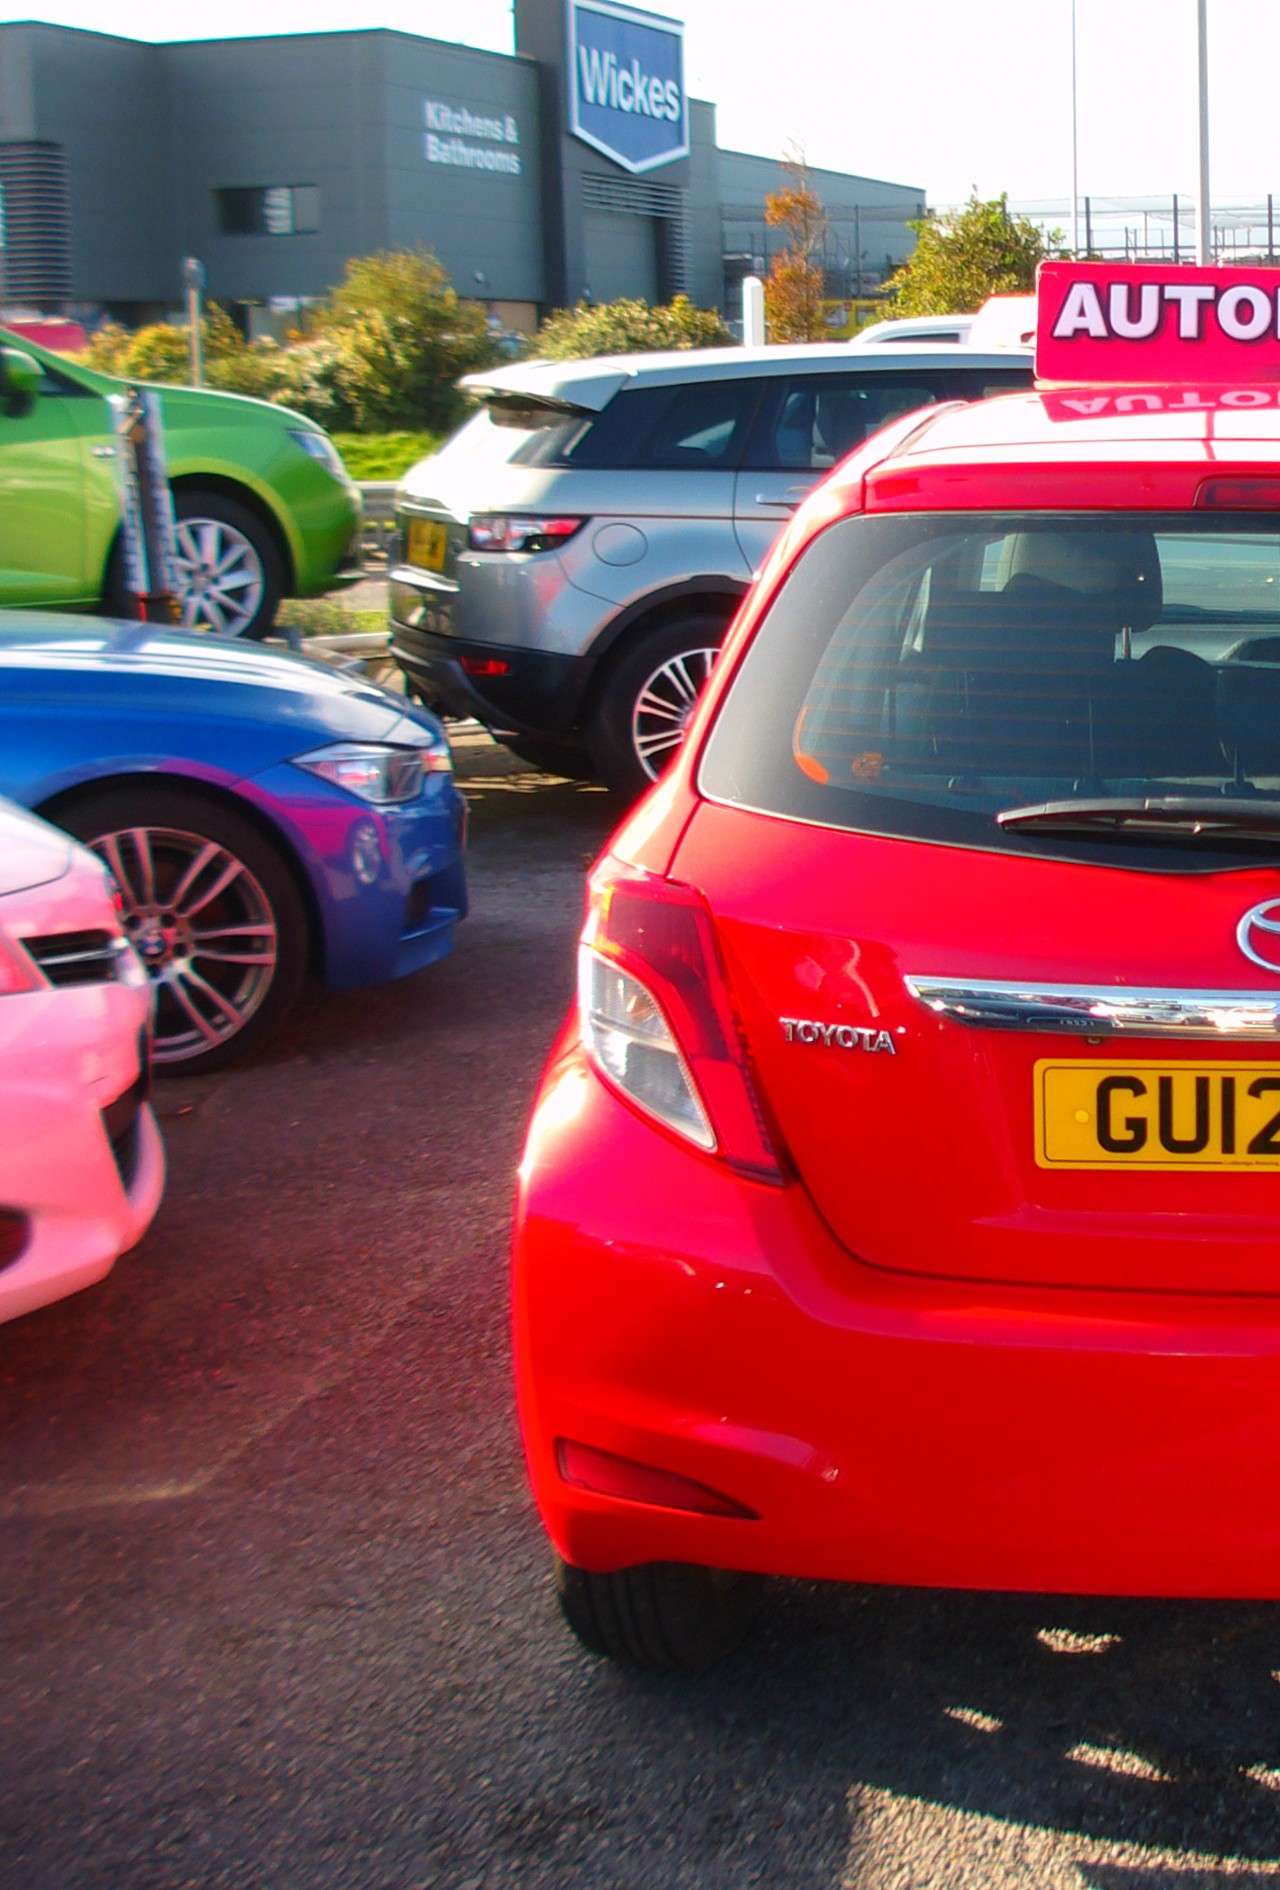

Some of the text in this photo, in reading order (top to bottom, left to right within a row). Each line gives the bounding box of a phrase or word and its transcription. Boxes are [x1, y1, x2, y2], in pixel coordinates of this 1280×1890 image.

[579, 45, 681, 122] Wickes
[424, 100, 521, 144] Kitchens &
[424, 133, 521, 175] Bathrooms
[779, 1017, 896, 1054] TOYOTA
